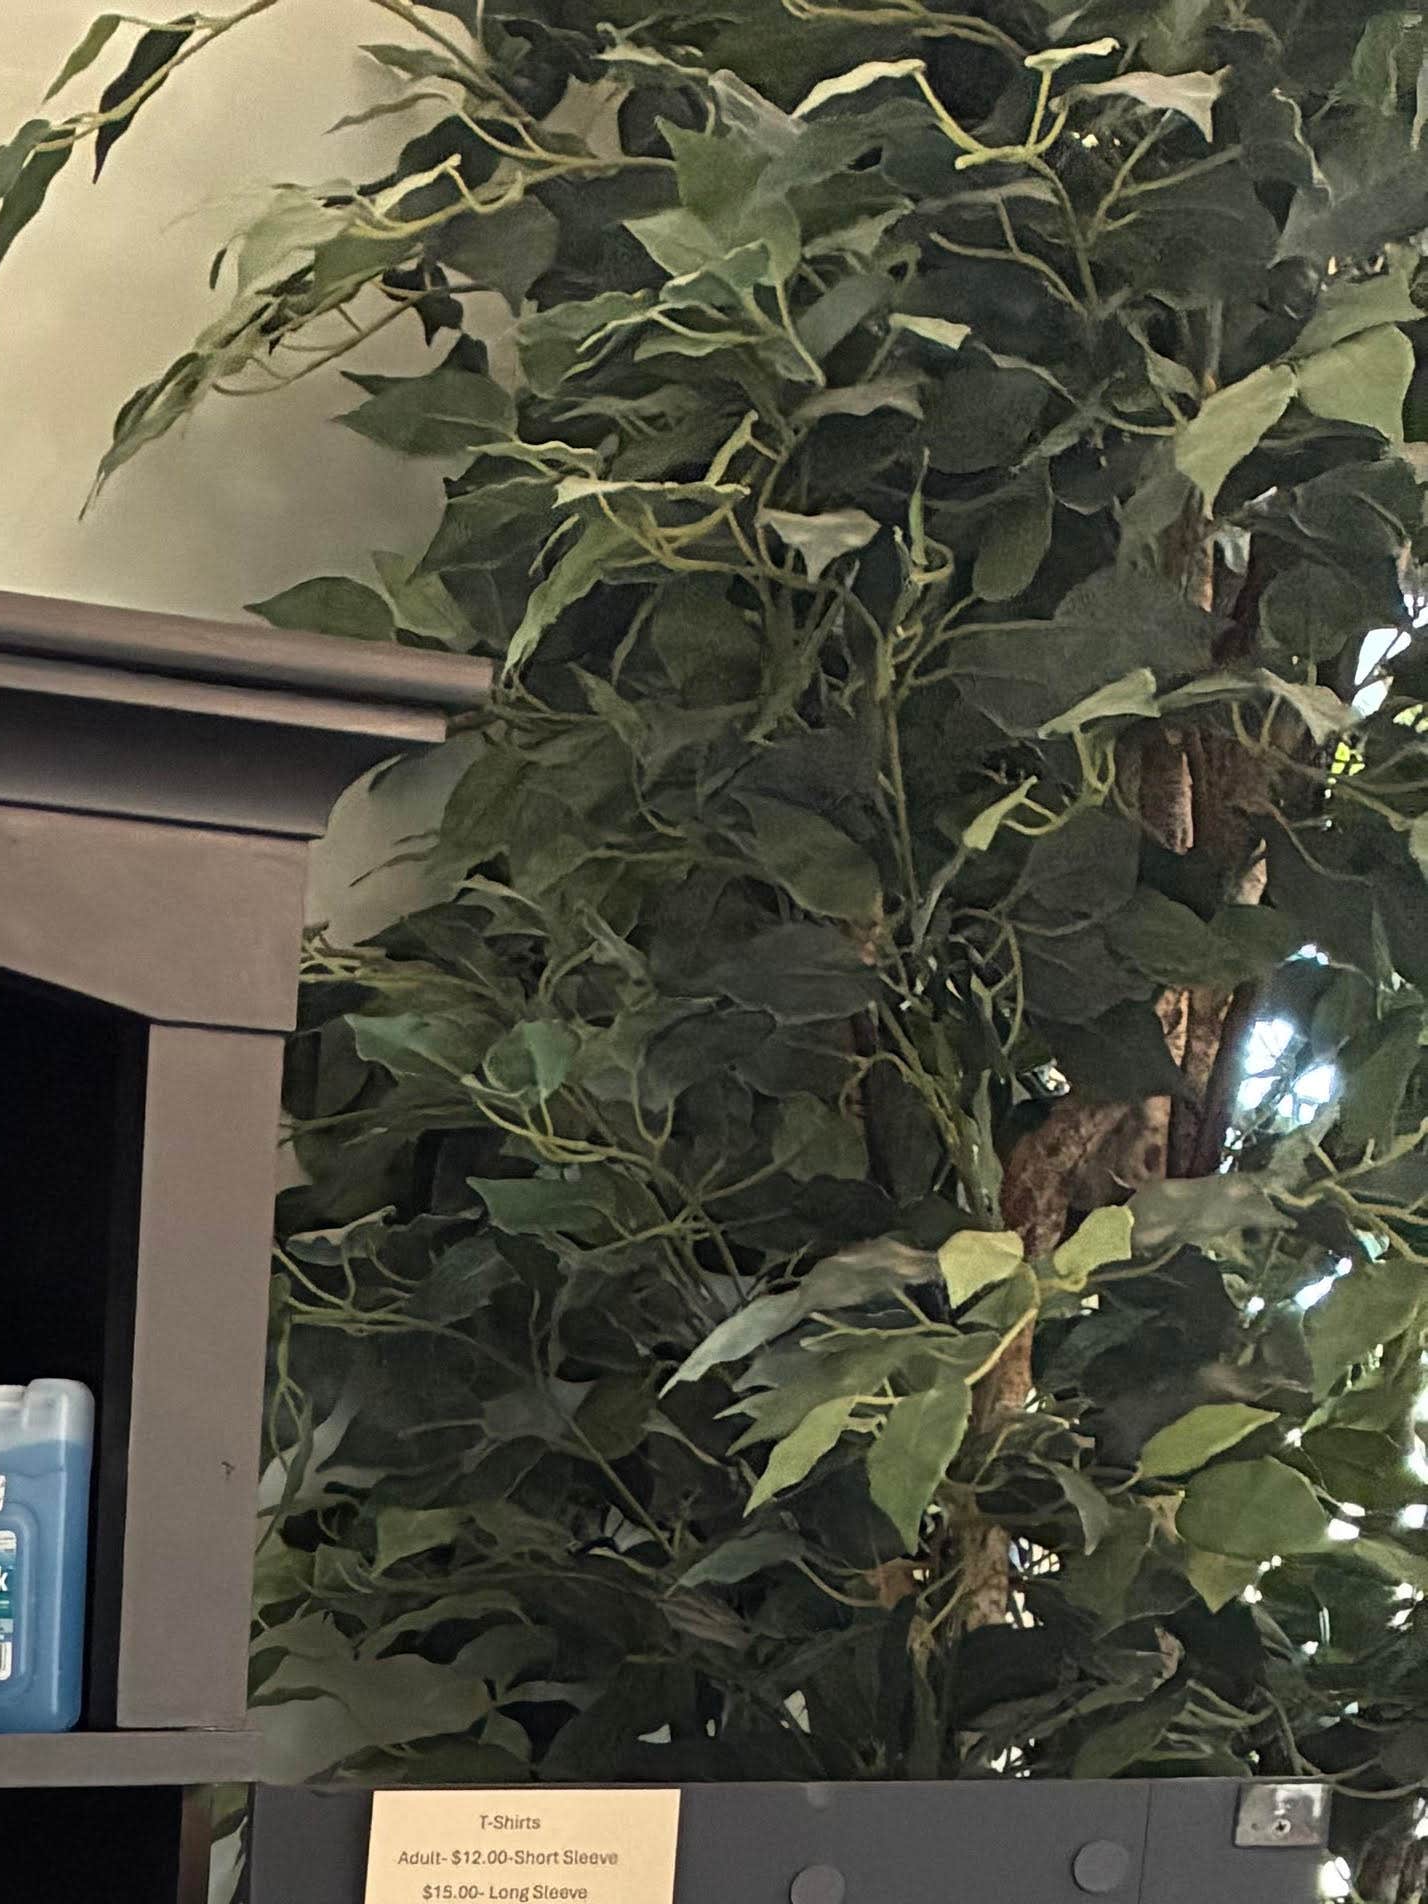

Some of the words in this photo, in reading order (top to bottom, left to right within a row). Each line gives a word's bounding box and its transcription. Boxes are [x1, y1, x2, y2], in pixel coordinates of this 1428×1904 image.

[480, 1814, 541, 1831] T-Shirts
[397, 1850, 448, 1866] Adult-
[562, 1850, 619, 1866] Sleeve
[489, 1885, 530, 1903] Long
[532, 1884, 588, 1900] Sleeve
